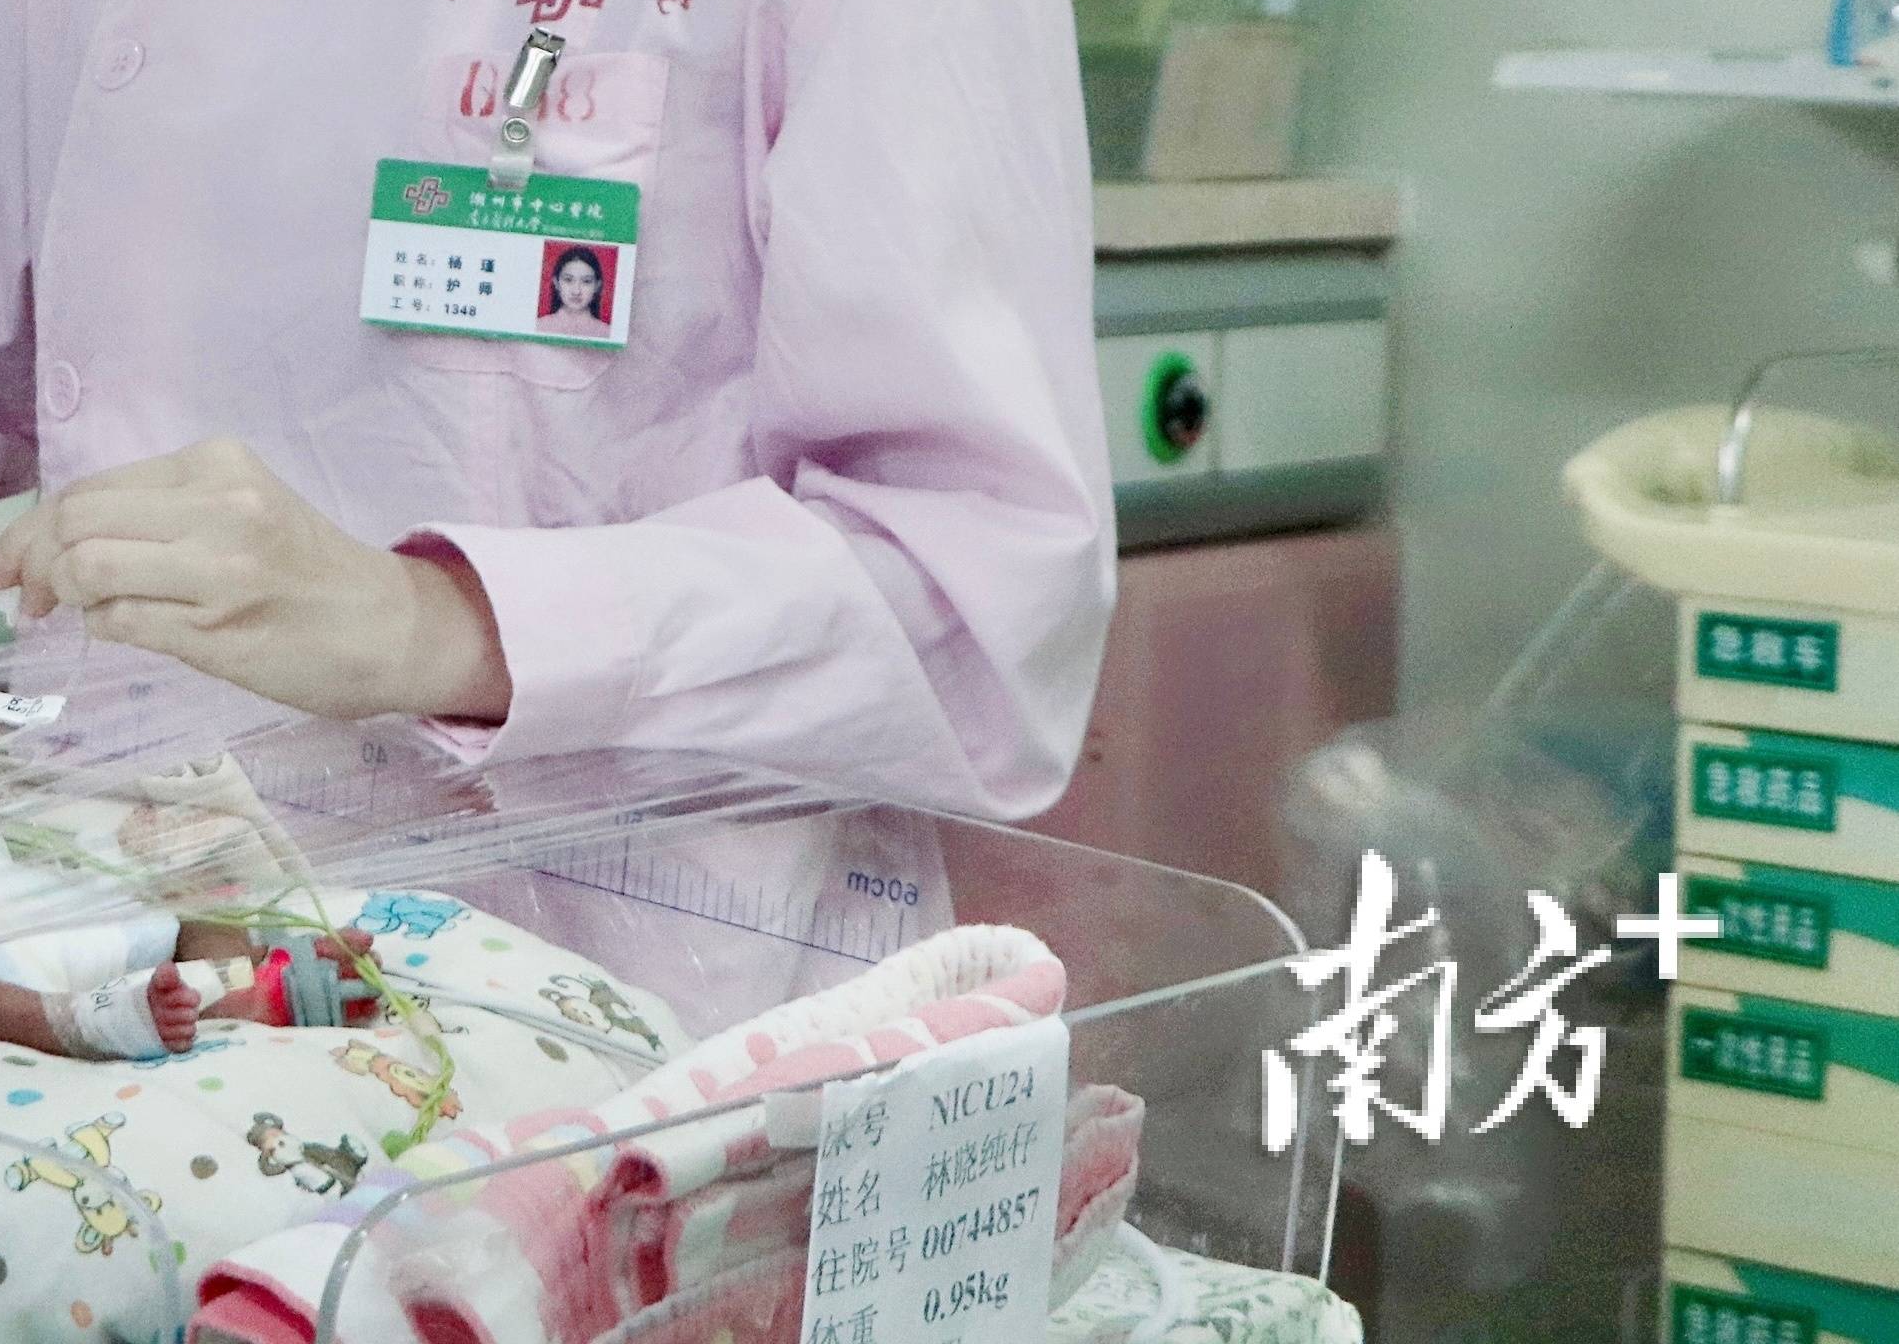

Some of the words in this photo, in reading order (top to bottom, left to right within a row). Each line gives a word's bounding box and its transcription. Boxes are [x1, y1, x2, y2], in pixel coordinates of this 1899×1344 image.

[443, 303, 477, 318] 1348
[930, 1066, 1035, 1132] NICU24
[816, 1170, 882, 1230] 姓名
[922, 1120, 1038, 1201] 林晓纯仔
[812, 1225, 911, 1297] 住院号
[922, 1187, 1040, 1260] 00744857
[923, 1270, 1010, 1325] 0.95kg
